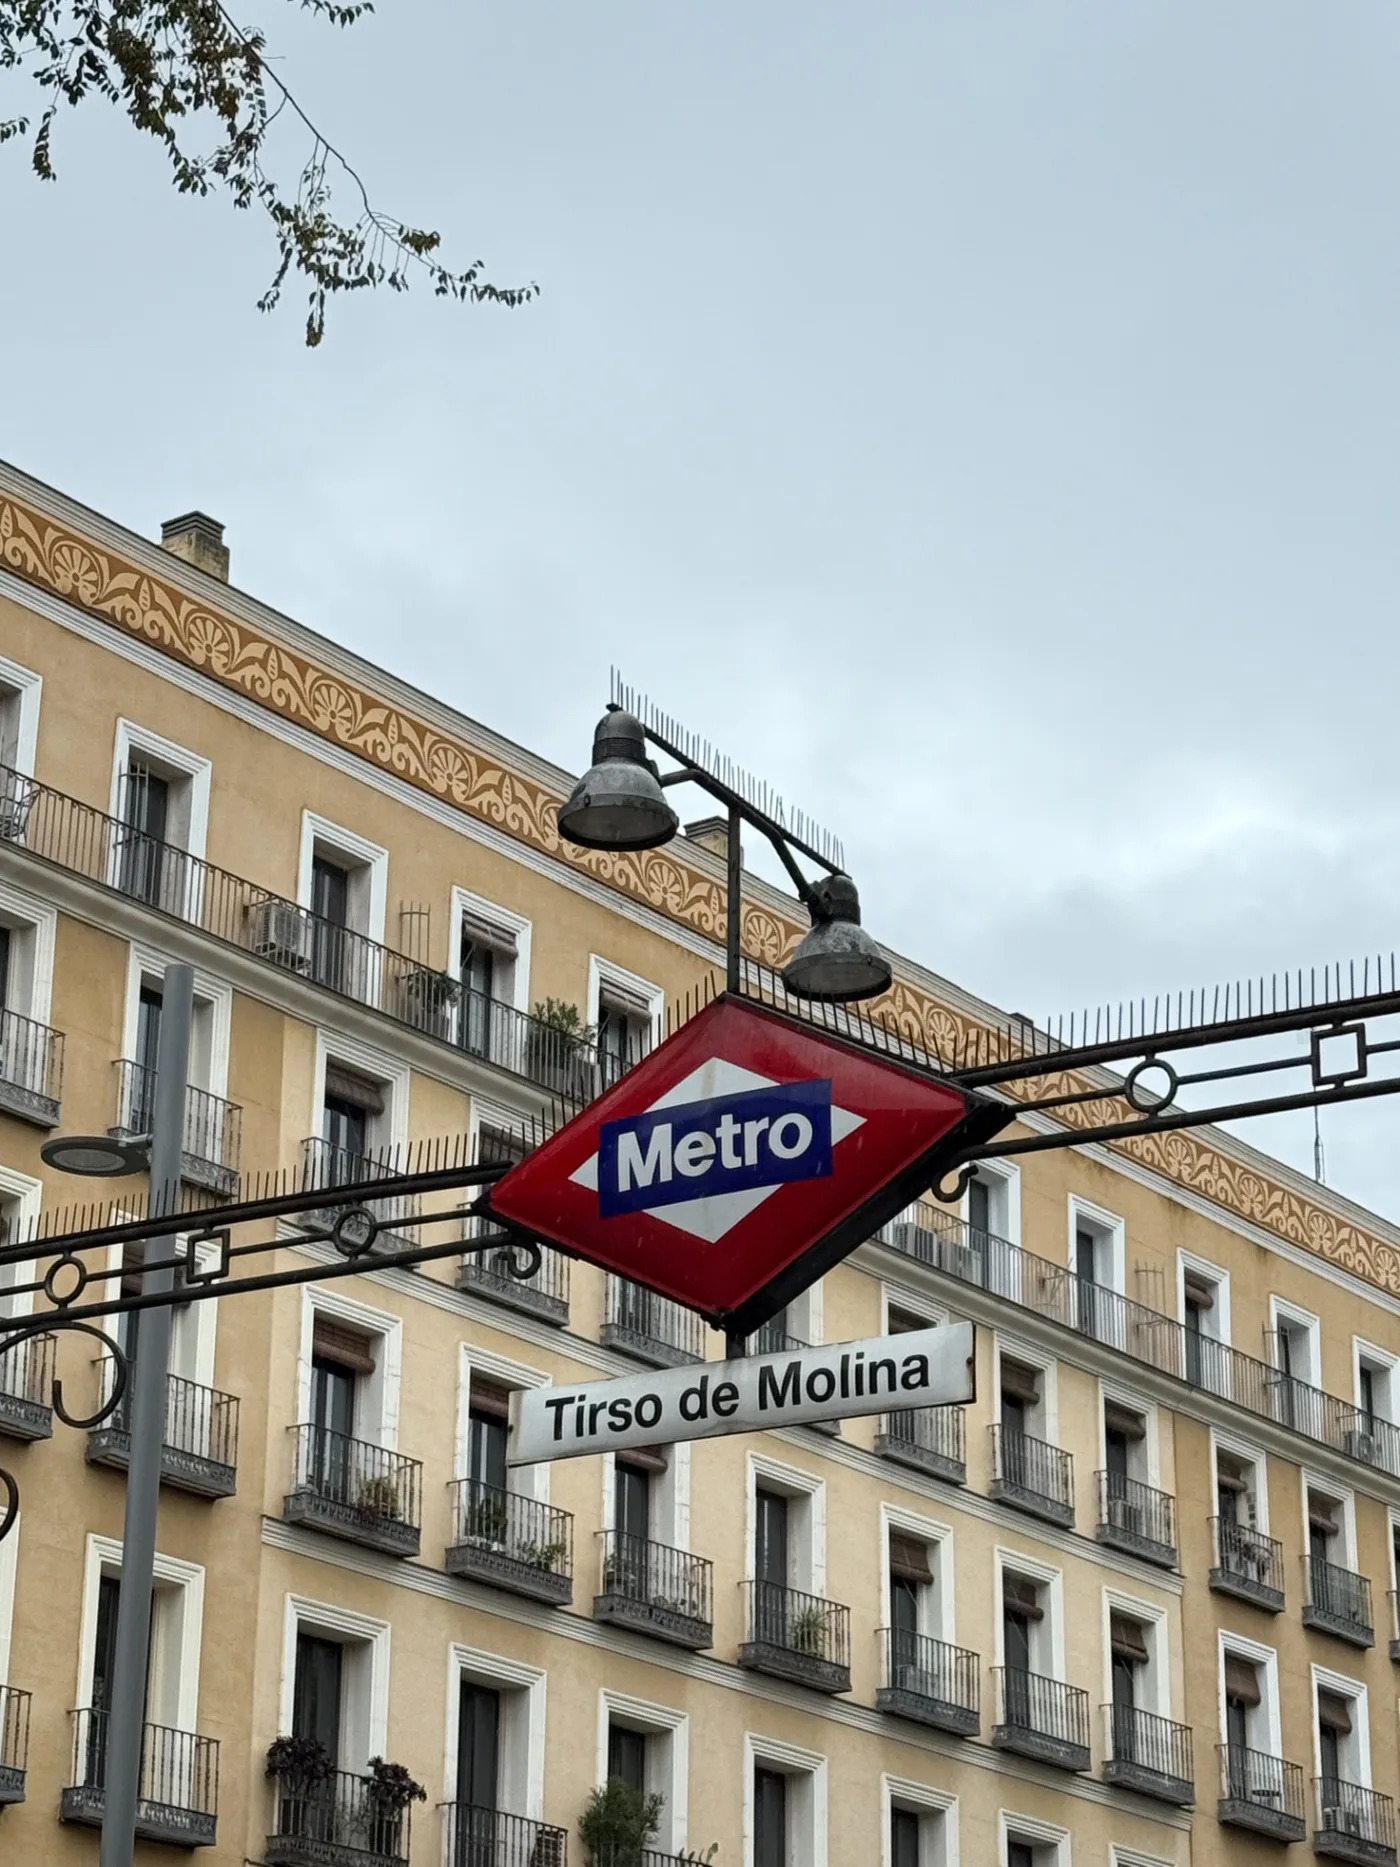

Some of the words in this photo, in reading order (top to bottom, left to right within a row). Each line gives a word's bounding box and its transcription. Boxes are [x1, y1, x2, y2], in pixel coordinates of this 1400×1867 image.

[617, 1112, 813, 1193] Metro
[545, 1393, 663, 1441] Tirso
[679, 1375, 739, 1421] de
[758, 1352, 930, 1410] Molina
